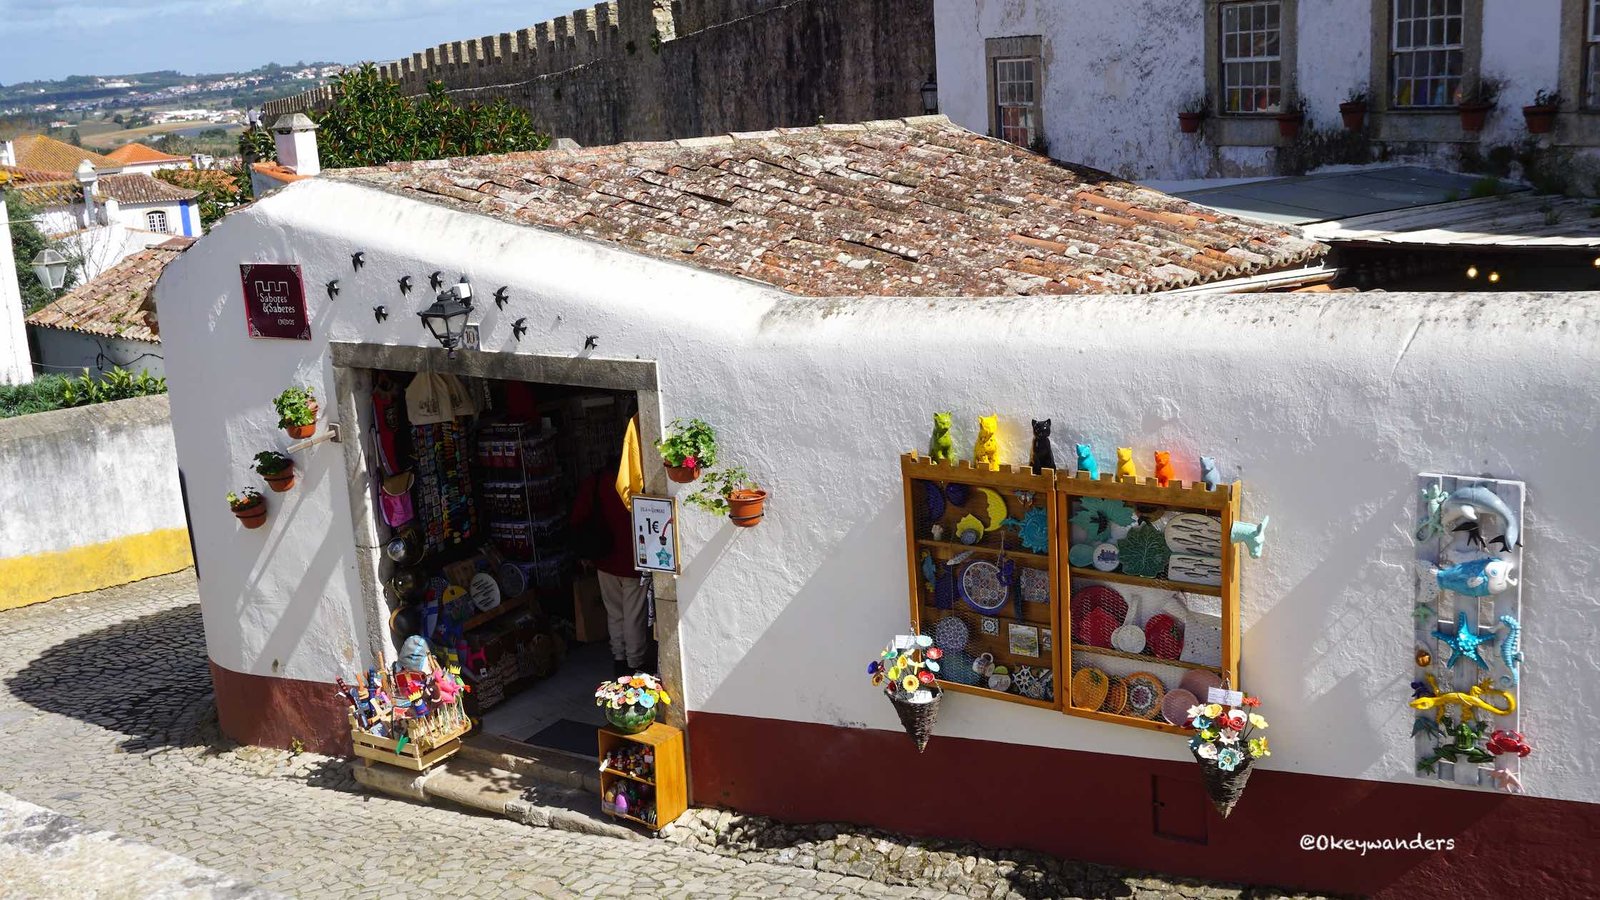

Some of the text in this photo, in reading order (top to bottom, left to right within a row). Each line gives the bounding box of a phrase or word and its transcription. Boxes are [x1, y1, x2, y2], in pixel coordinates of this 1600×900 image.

[259, 292, 288, 303] Sabores
[465, 330, 475, 344] 10
[645, 517, 660, 535] 1€
